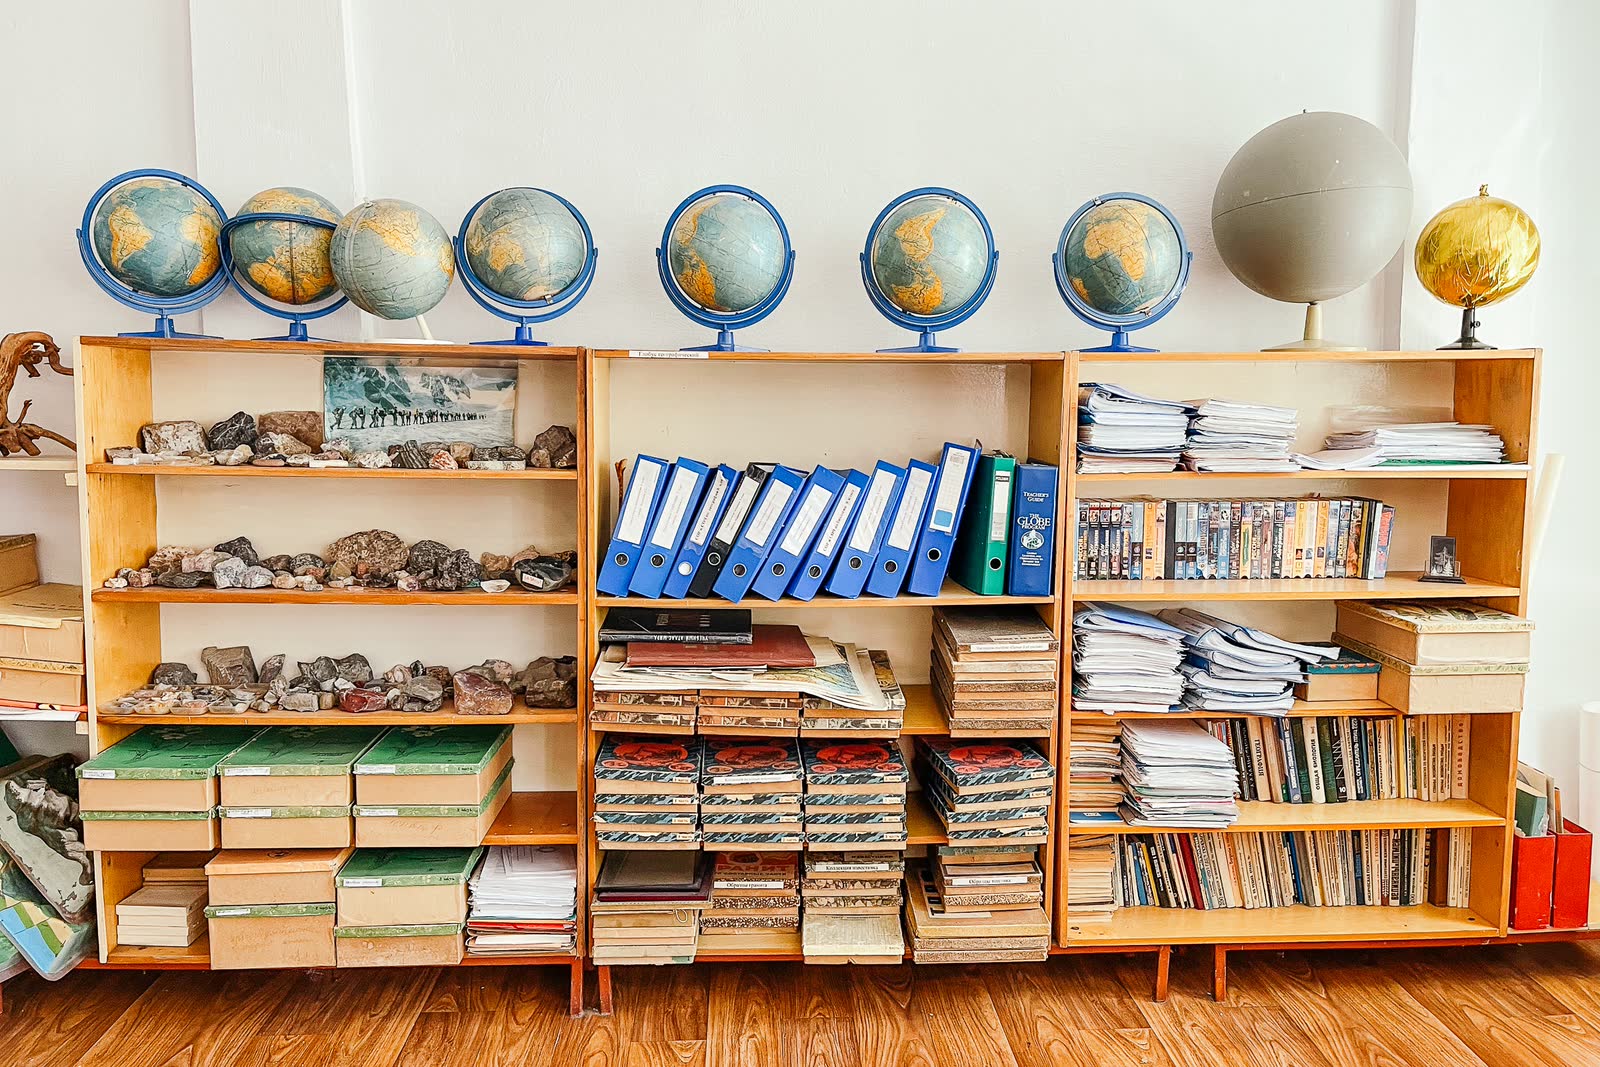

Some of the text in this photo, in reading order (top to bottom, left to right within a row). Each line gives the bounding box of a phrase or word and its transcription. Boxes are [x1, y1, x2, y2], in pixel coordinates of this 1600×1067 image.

[1017, 516, 1051, 527] GLOBE
[1254, 739, 1264, 776] ГЕОГРАФИЯ
[1310, 739, 1318, 768] БИОЛОГИЯ
[718, 864, 789, 872] РАНИТ
